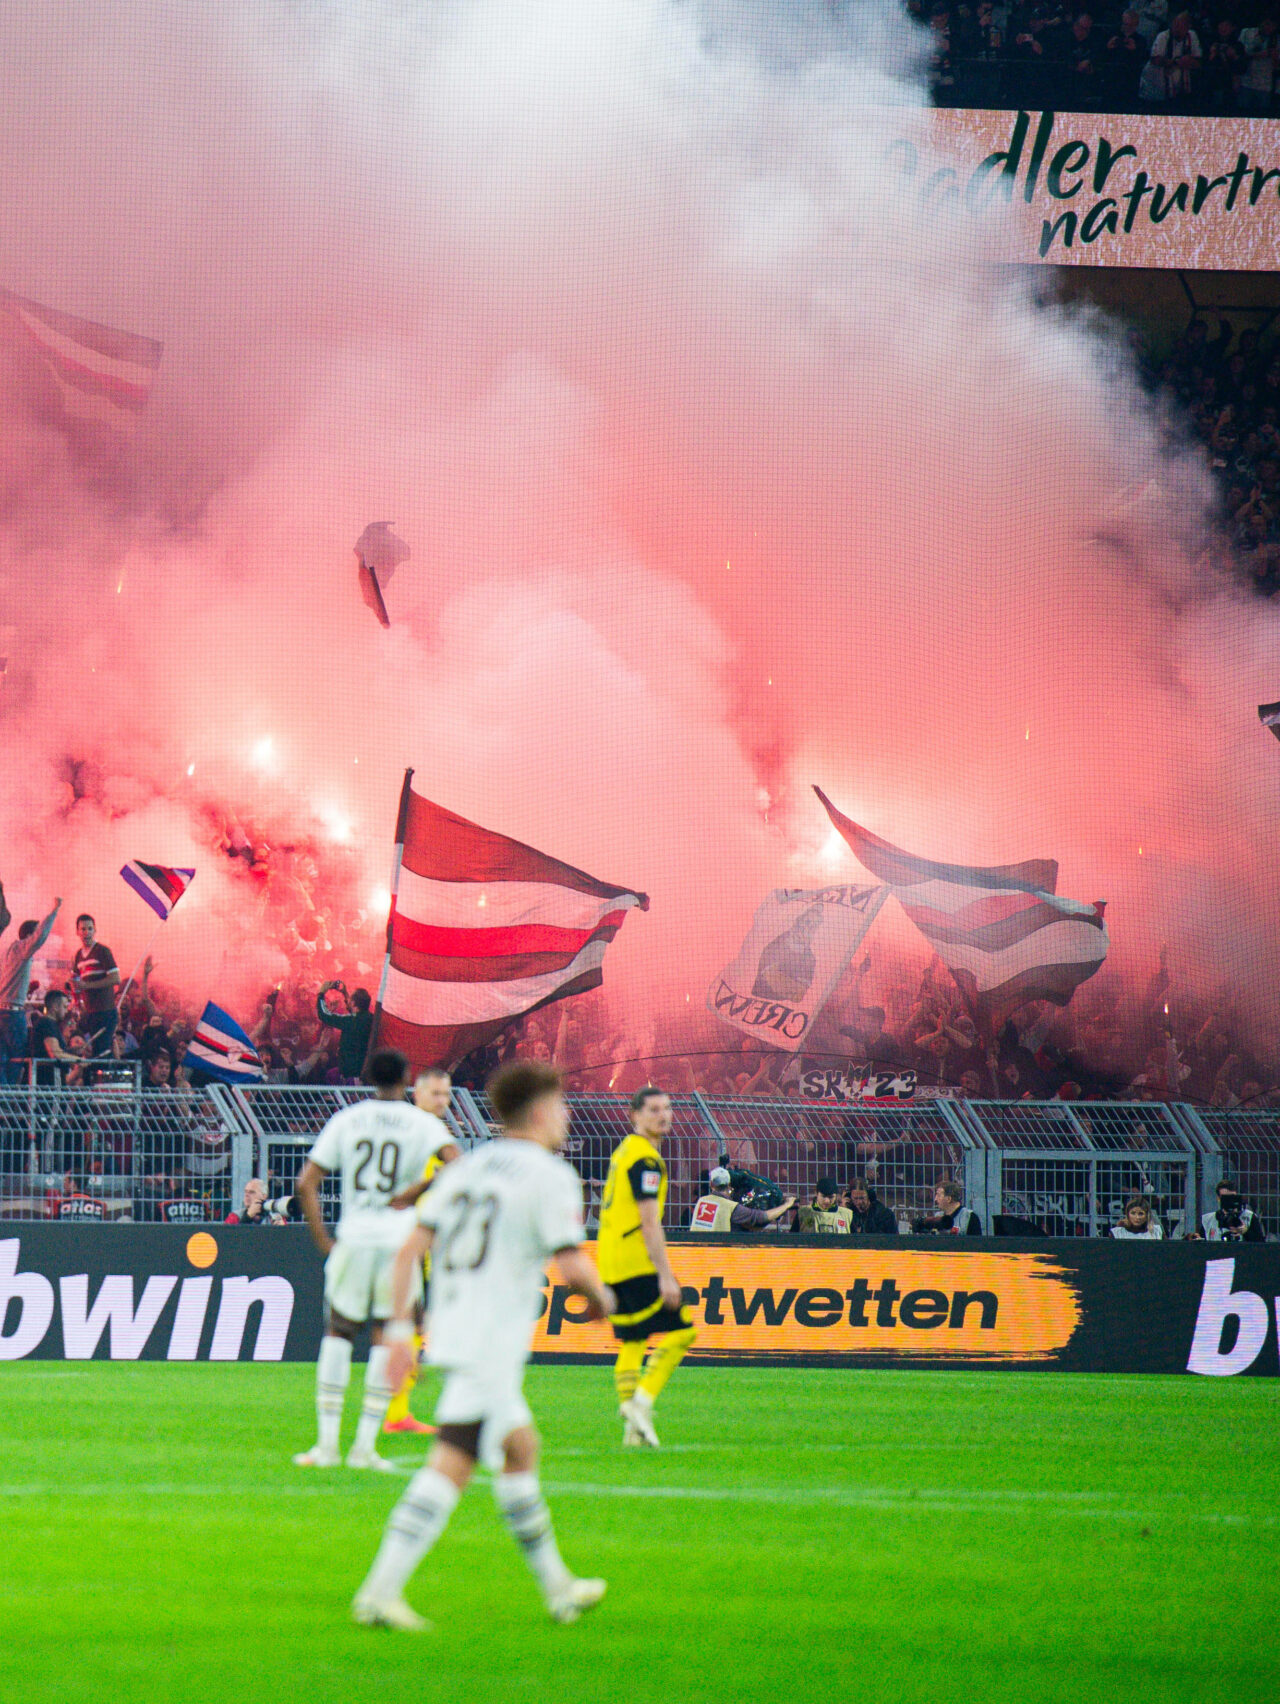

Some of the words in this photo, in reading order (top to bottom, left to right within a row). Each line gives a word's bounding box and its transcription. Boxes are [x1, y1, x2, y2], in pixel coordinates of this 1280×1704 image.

[803, 1070, 845, 1100] SK
[875, 1070, 916, 1100] 23
[354, 1139, 399, 1193] 29
[534, 1272, 1000, 1335] ptwetten
[1186, 1258, 1280, 1376] b
